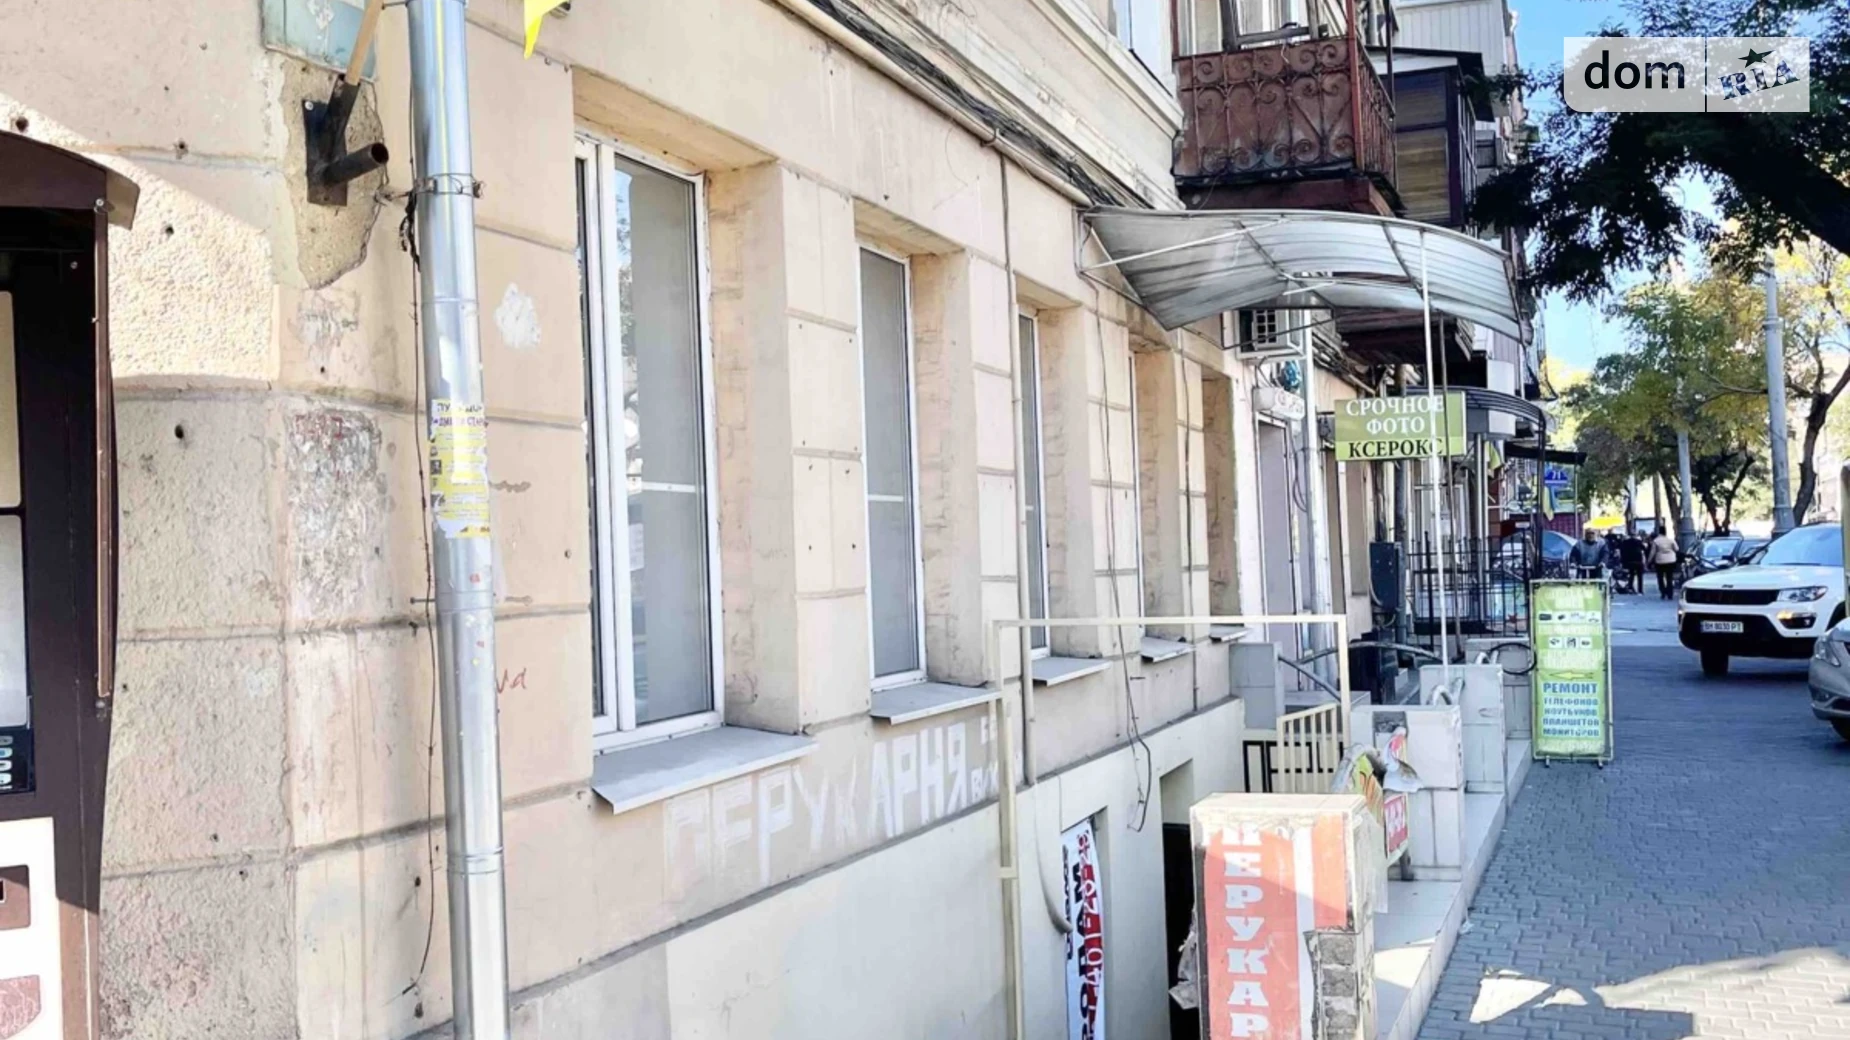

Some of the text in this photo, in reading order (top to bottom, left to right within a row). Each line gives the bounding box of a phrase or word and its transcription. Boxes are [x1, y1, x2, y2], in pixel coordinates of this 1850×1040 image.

[1345, 394, 1444, 416] СРОЧНОЕ
[1366, 416, 1425, 435] ФОТО
[1348, 438, 1443, 458] КСЕРОКС
[1543, 682, 1597, 694] РЕМОНТ
